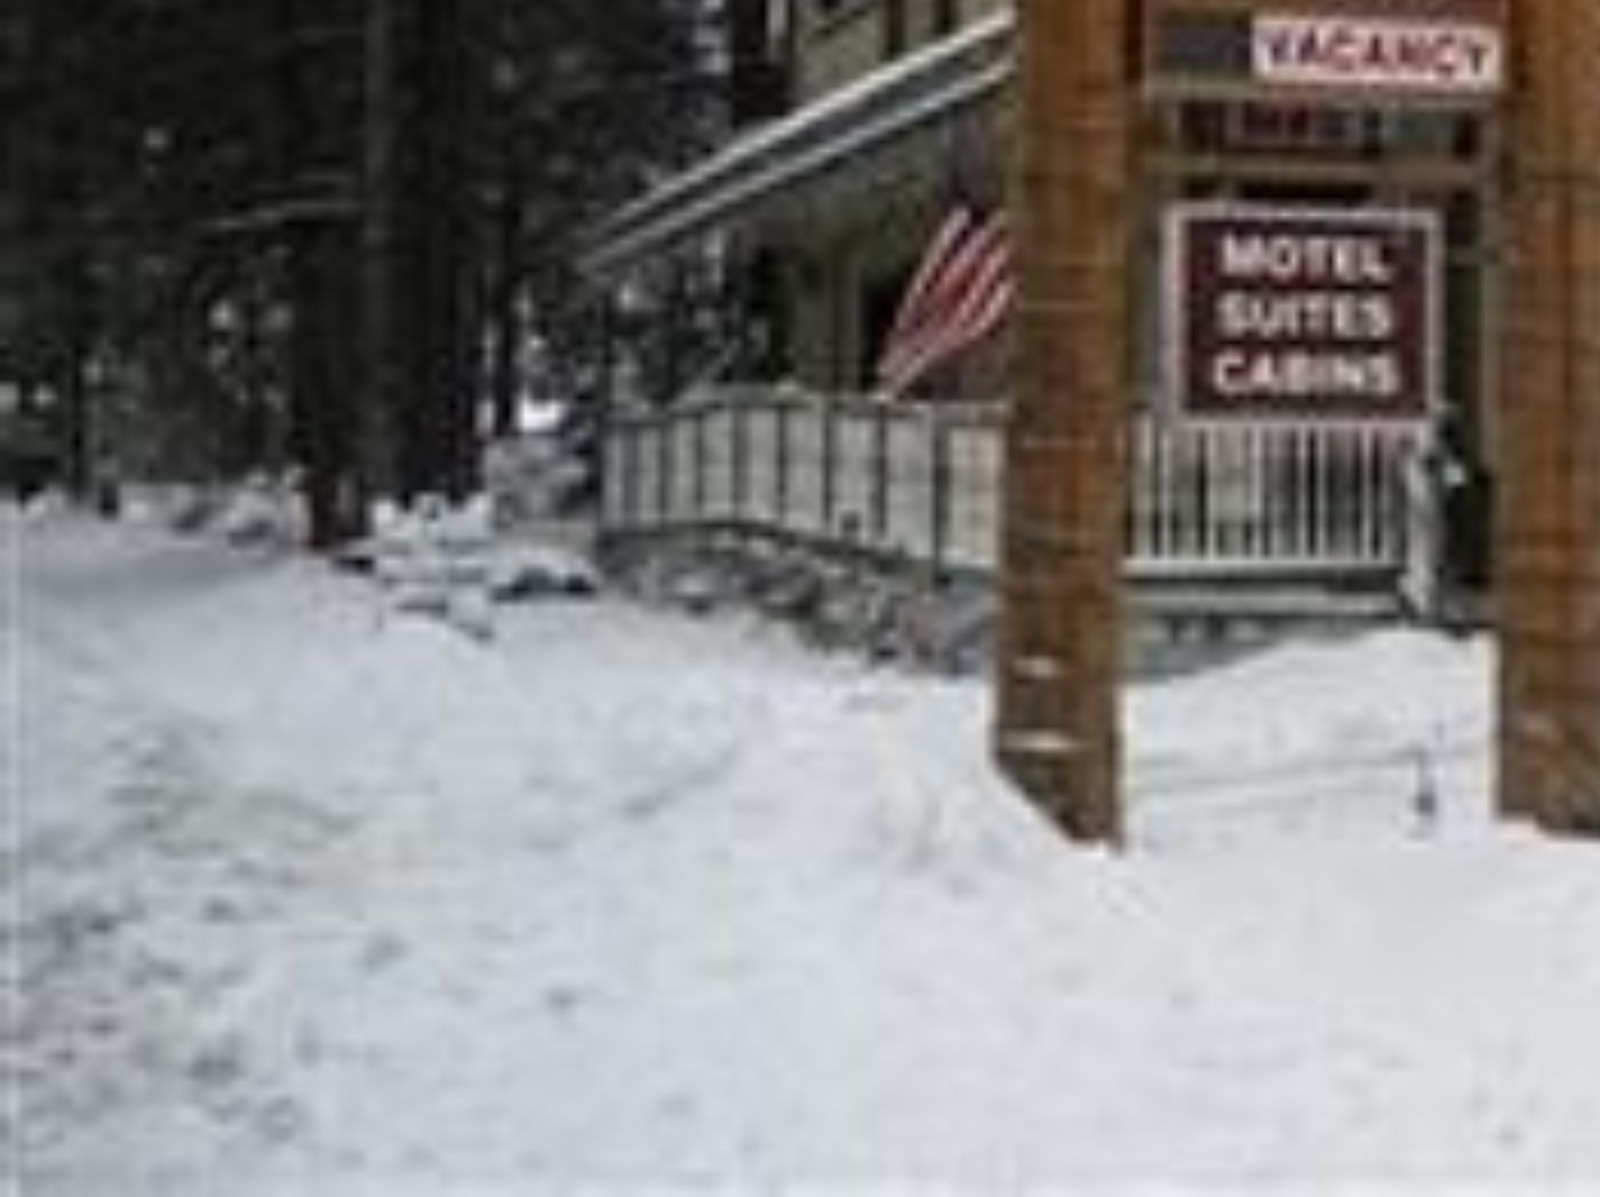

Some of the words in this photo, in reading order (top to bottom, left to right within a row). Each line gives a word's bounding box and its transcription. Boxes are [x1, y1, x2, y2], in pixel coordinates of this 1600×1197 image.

[1260, 26, 1491, 75] VACANCY
[1219, 231, 1394, 281] MOTEL
[1216, 292, 1393, 339] SUITES
[1211, 349, 1399, 396] CABINS
